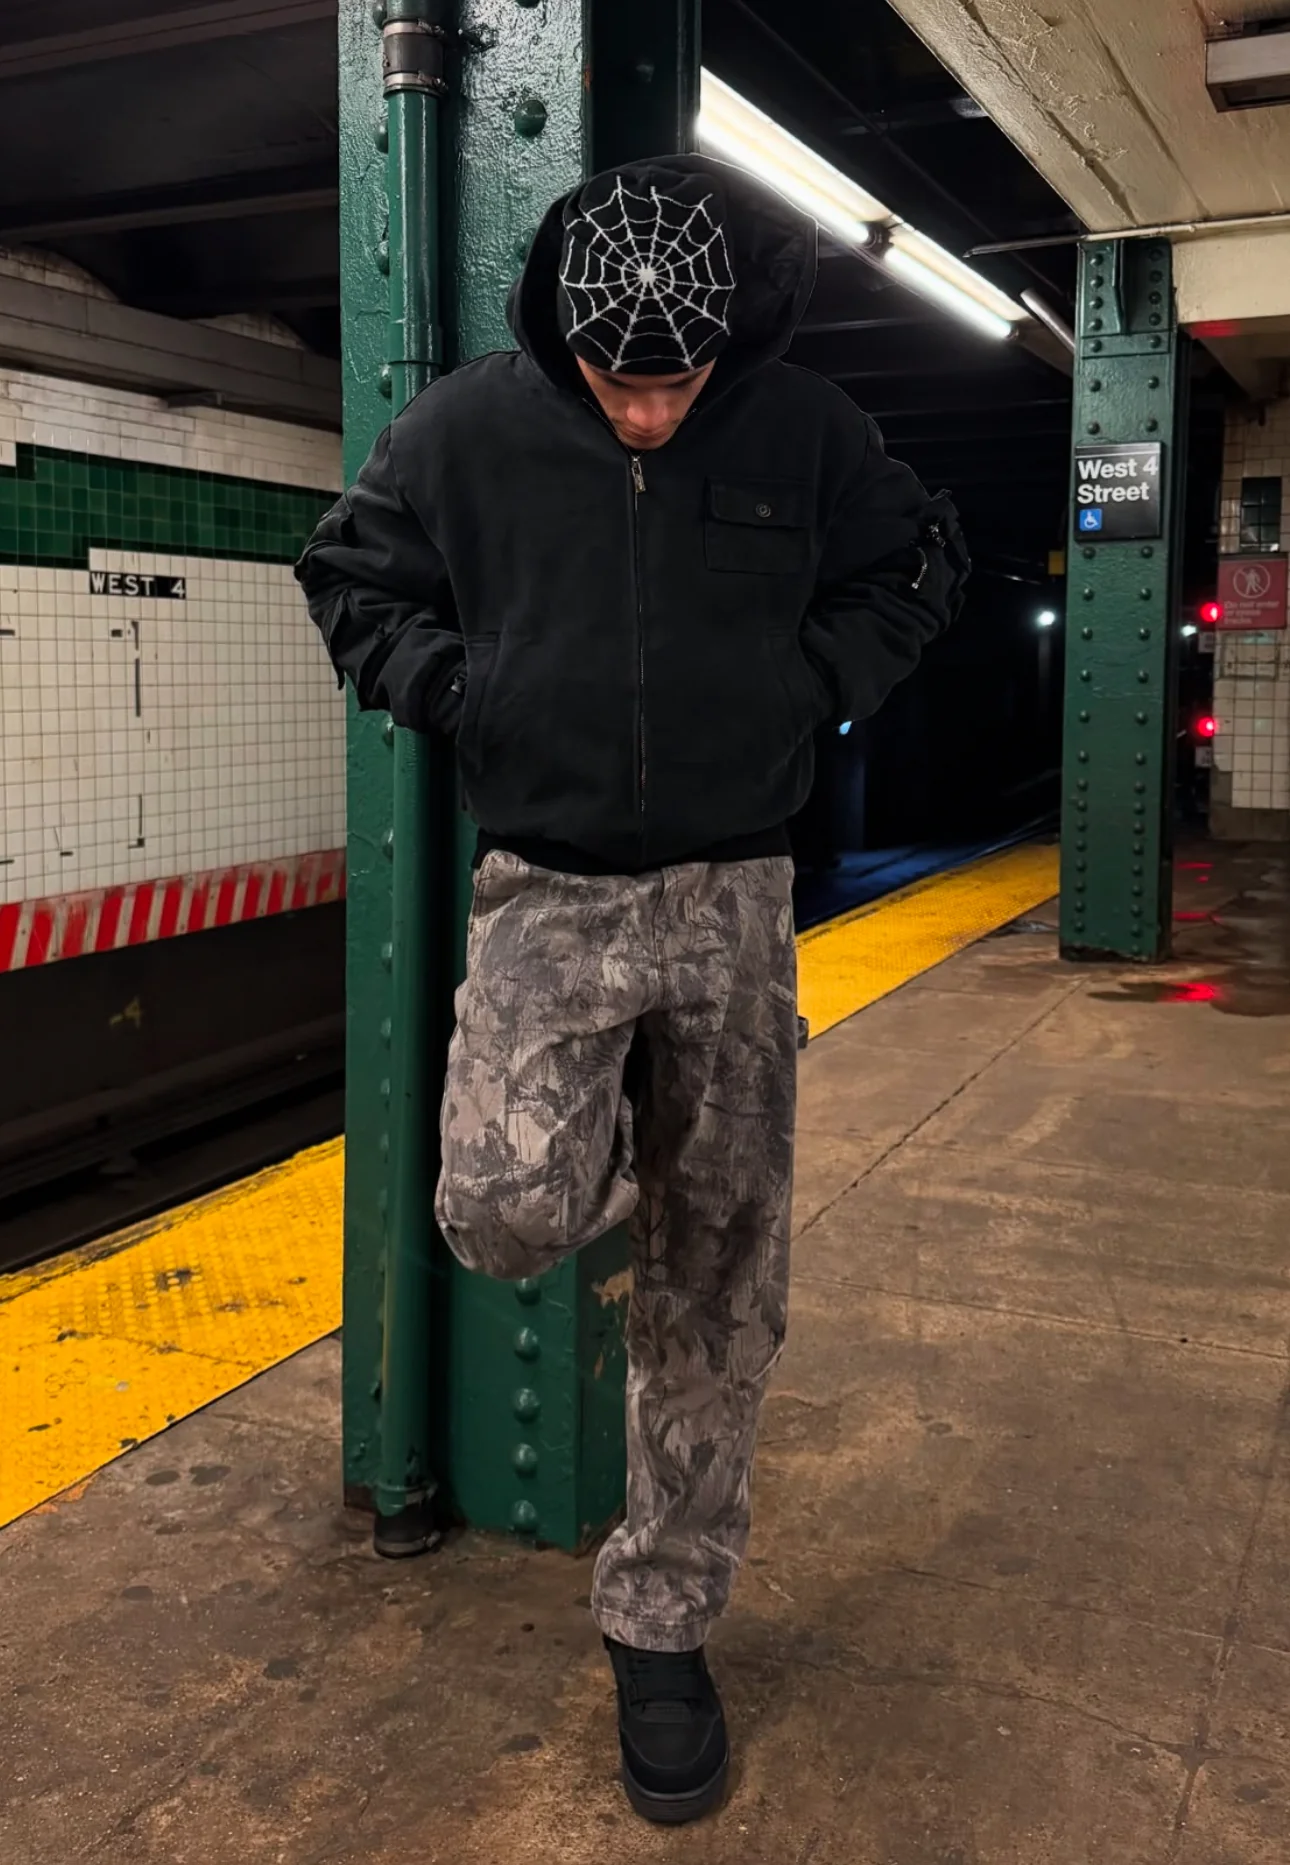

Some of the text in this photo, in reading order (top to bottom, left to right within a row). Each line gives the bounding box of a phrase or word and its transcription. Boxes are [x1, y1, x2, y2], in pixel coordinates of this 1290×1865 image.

[1078, 456, 1158, 480] West 4
[1077, 481, 1150, 504] Street
[91, 572, 185, 599] WEST 4
